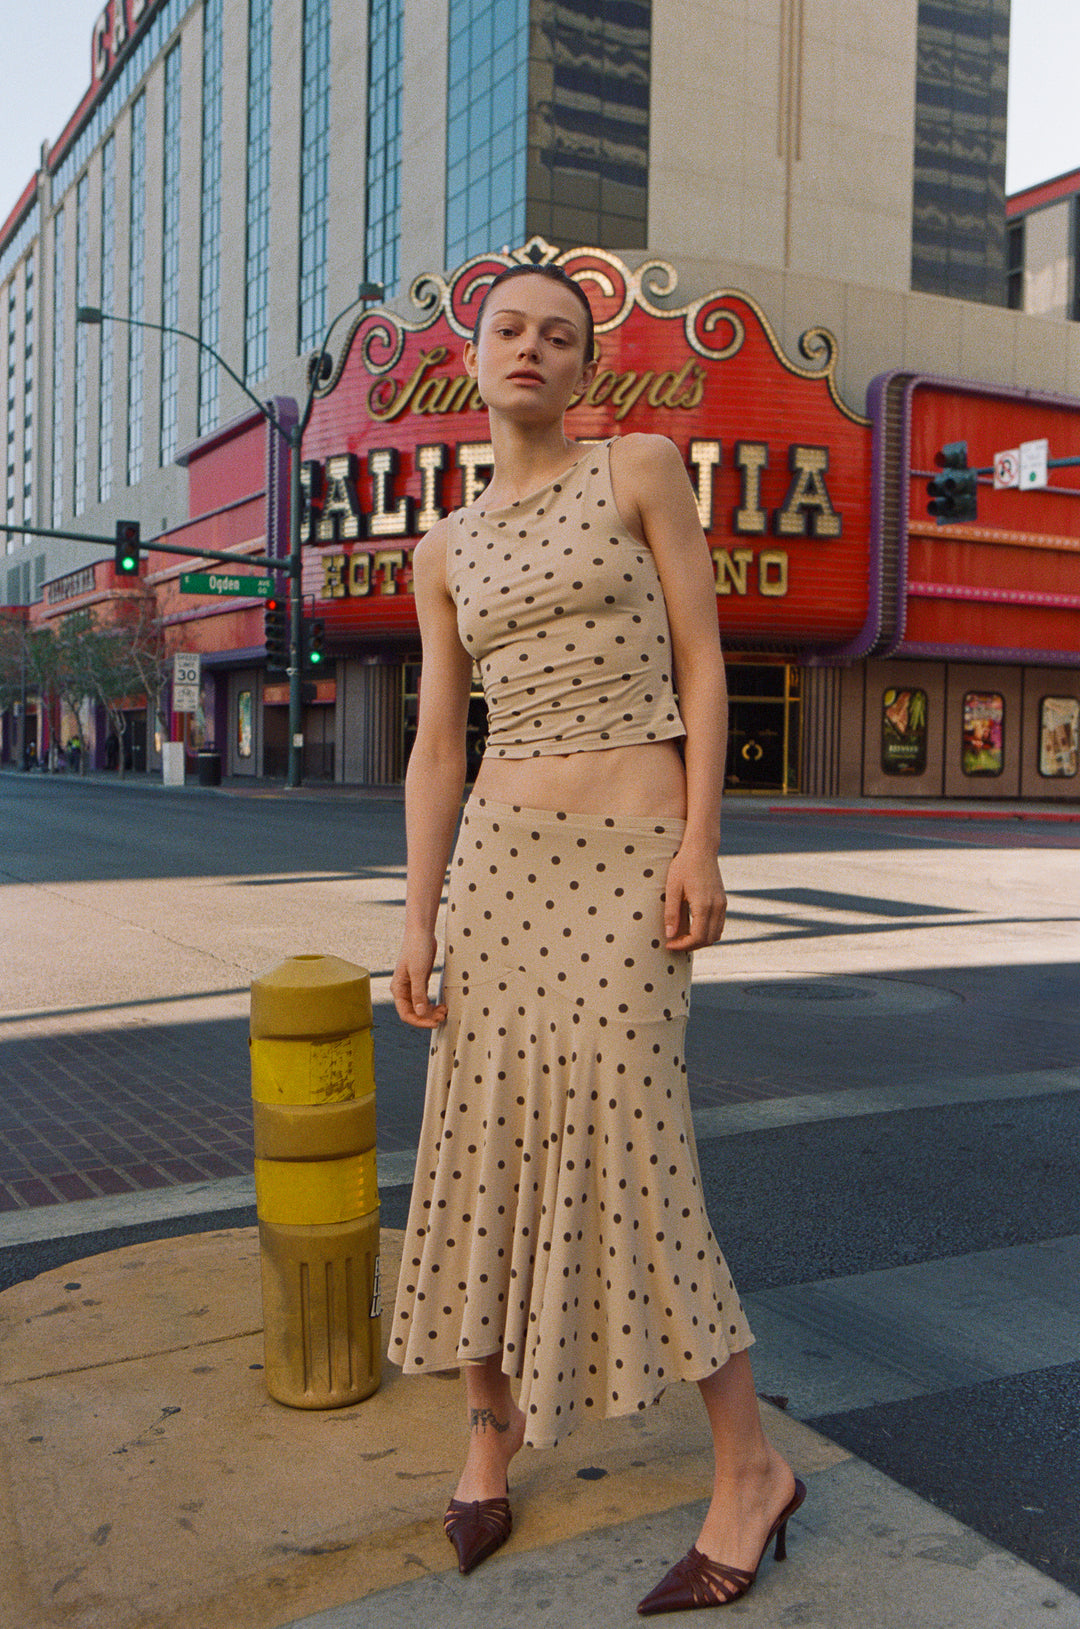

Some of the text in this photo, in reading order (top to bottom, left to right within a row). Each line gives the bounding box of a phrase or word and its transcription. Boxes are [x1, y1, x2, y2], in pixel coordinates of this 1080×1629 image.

[94, 0, 146, 80] CA
[567, 340, 707, 421] oyd's
[300, 437, 842, 544] ALIFIA
[209, 575, 240, 594] Ogden
[257, 580, 271, 588] AVE
[320, 549, 415, 600] HOT
[177, 668, 196, 681] 30
